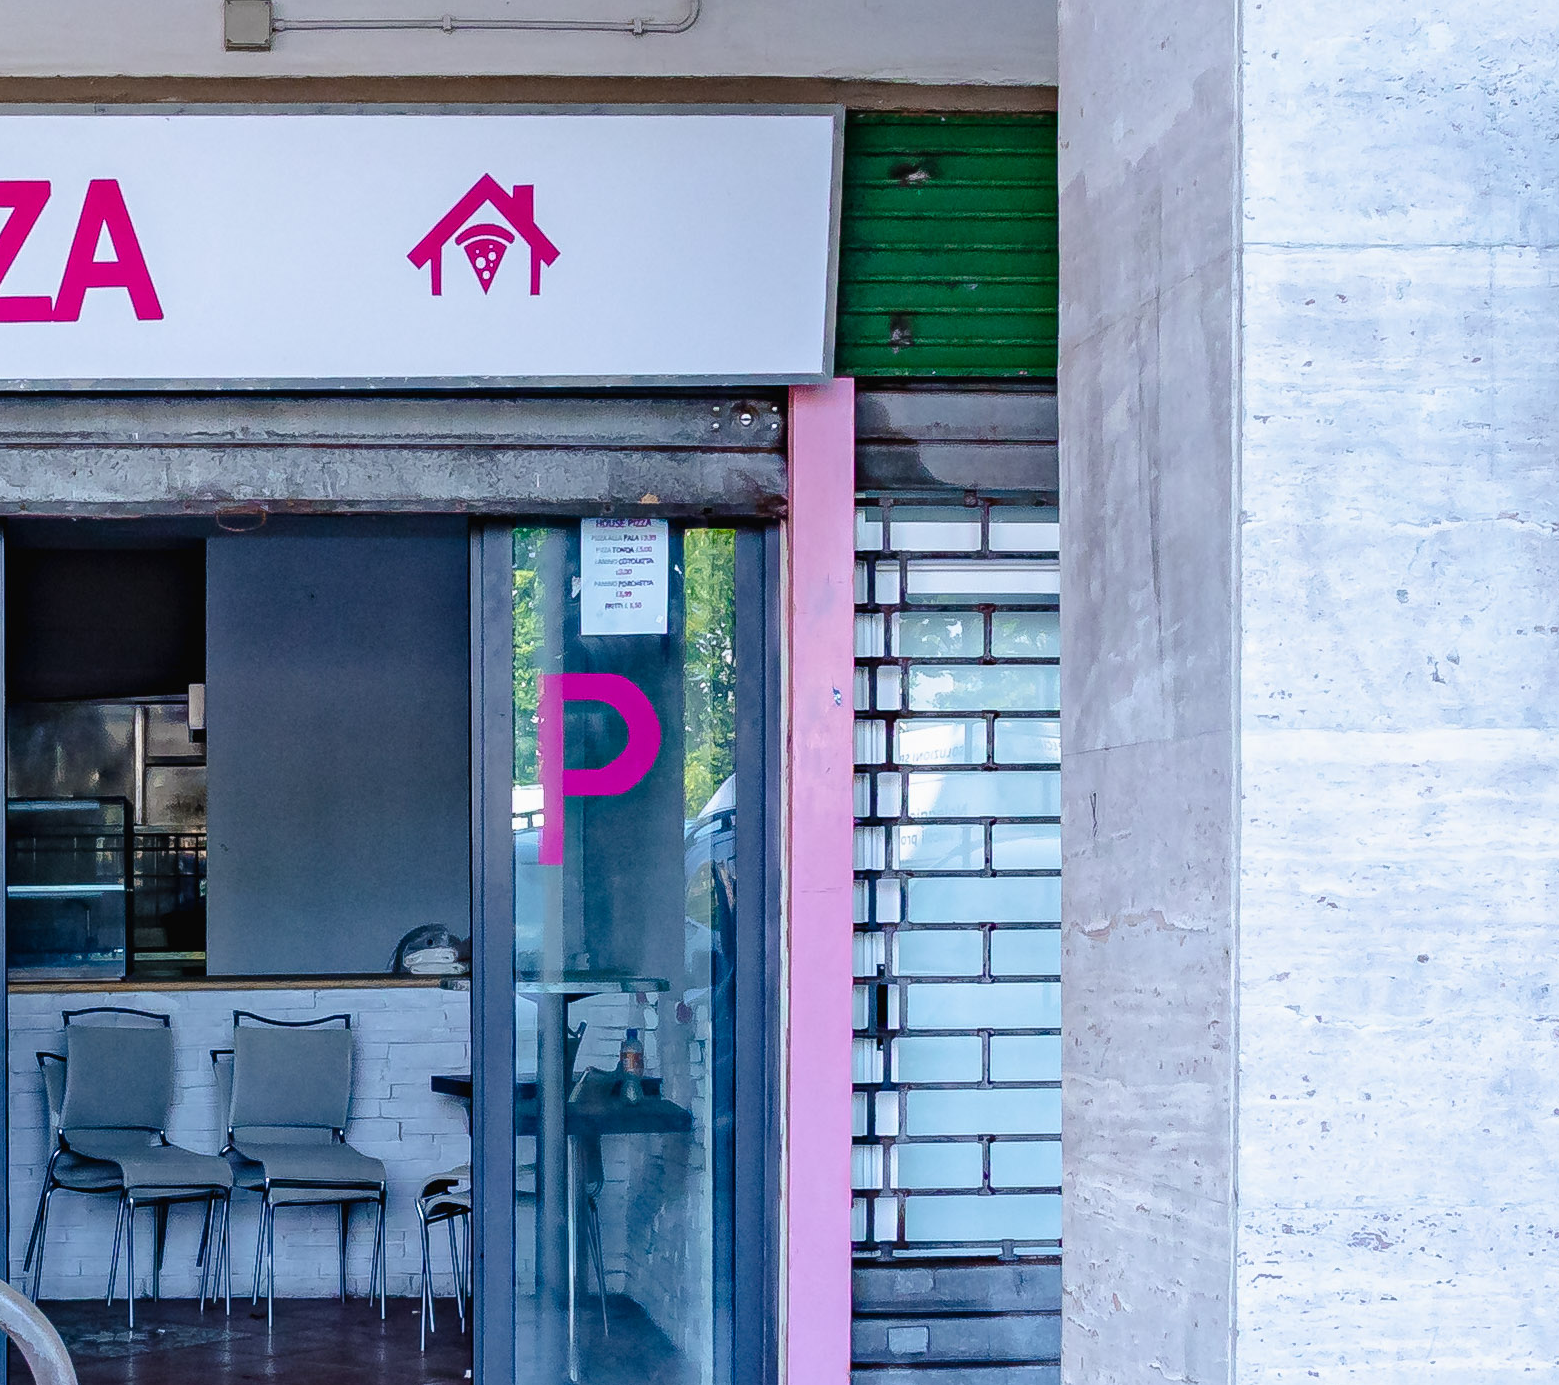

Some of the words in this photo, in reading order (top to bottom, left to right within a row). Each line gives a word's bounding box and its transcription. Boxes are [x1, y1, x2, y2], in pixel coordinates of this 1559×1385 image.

[595, 519, 626, 528] HOUSE
[628, 519, 652, 528] PIZZA
[538, 672, 661, 865] P
